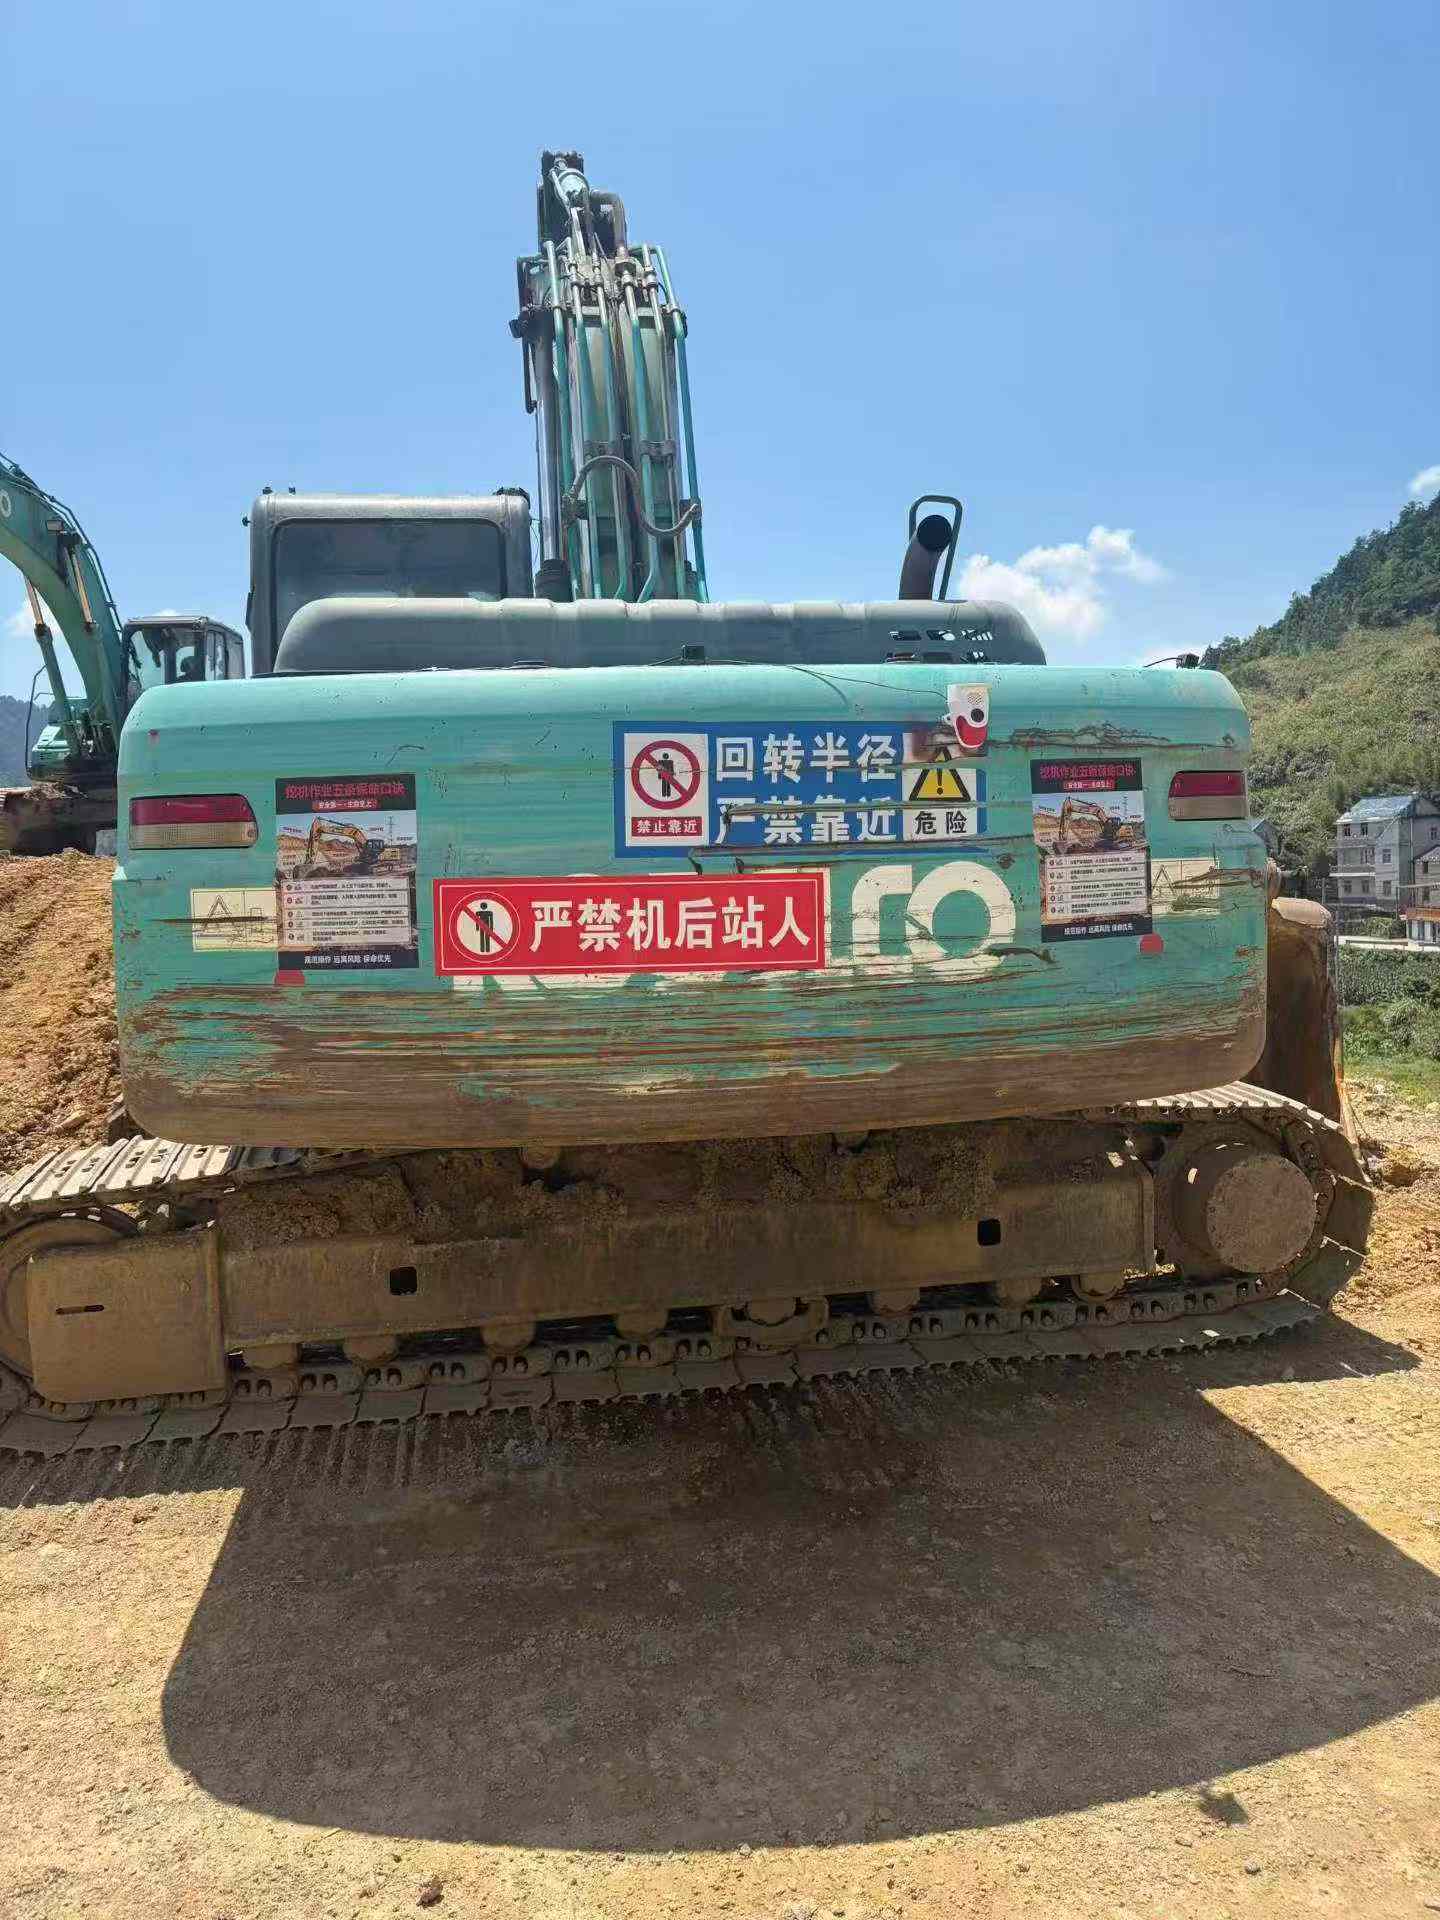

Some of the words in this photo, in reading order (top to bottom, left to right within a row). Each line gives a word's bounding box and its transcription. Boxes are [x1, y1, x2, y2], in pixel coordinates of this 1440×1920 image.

[715, 731, 898, 784] 回转半径
[636, 818, 699, 835] 禁止靠近
[714, 795, 898, 846] 严禁靠近
[915, 810, 969, 836] 危险
[529, 894, 812, 954] 严禁机后站人
